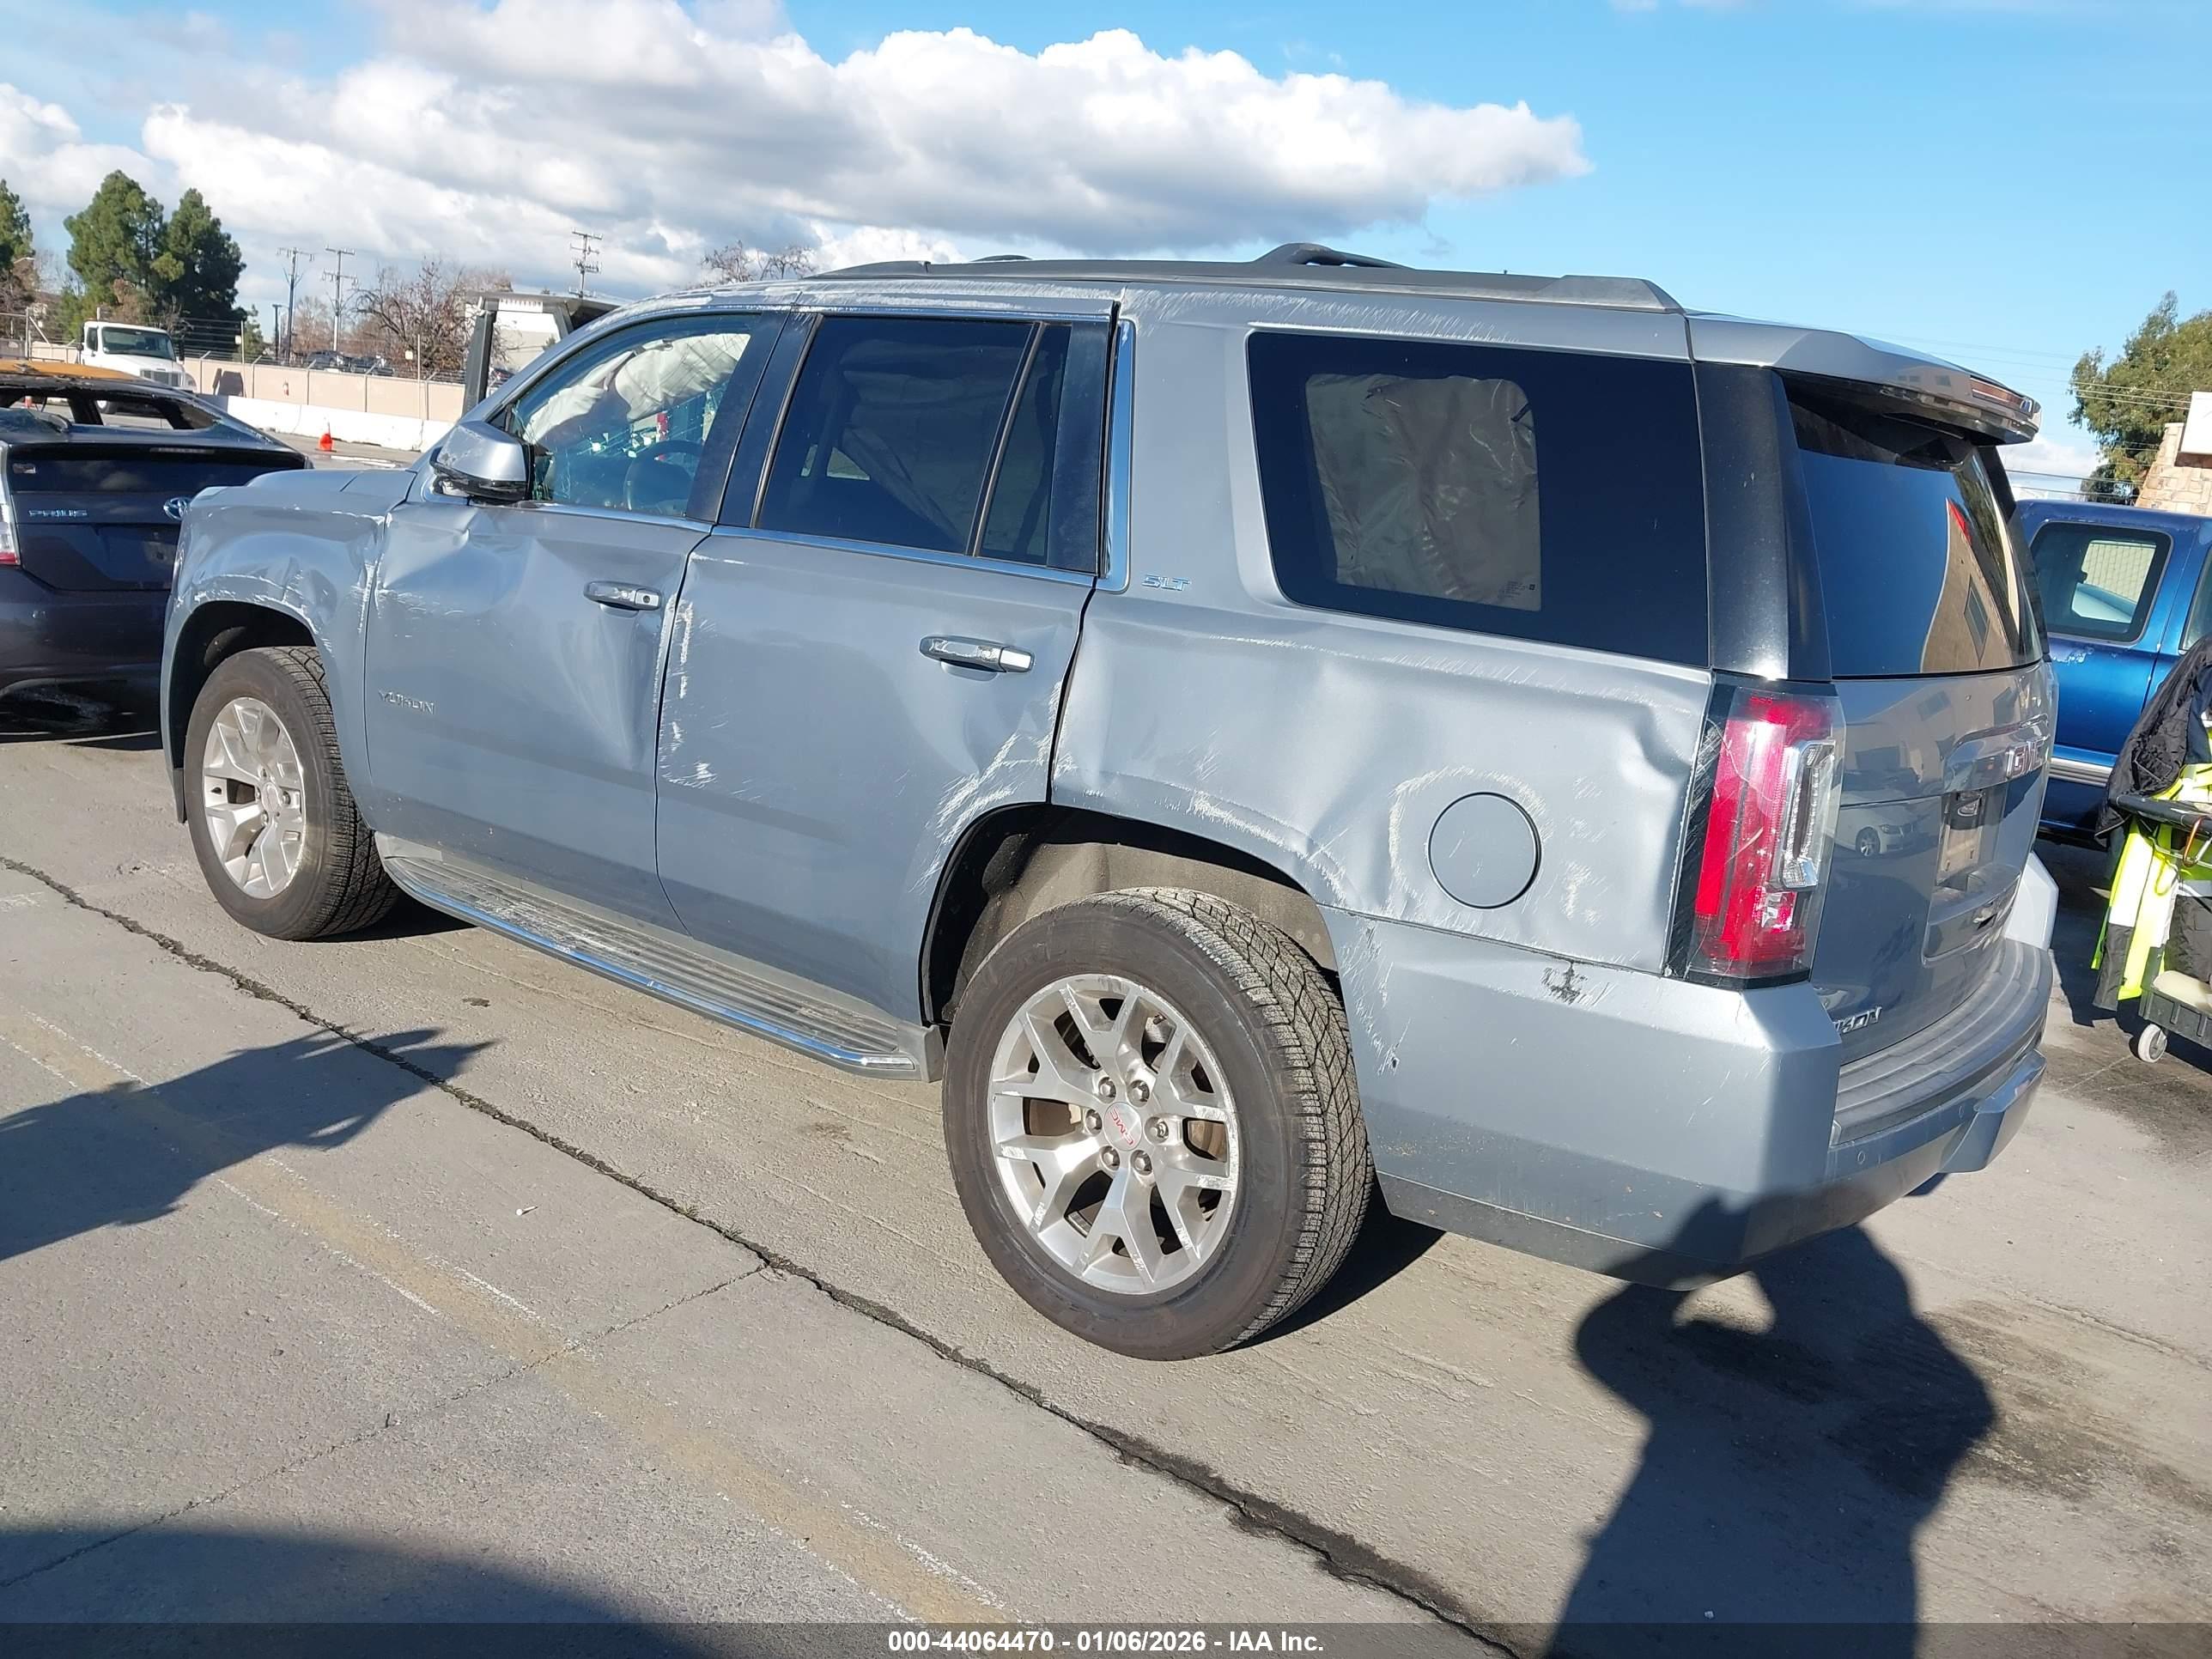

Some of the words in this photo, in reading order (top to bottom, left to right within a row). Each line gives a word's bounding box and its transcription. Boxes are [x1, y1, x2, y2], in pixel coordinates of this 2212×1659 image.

[1141, 574, 1192, 592] SLT
[378, 689, 434, 715] YUKON
[2005, 738, 2047, 780] GMC
[1109, 1108, 1134, 1146] GMC
